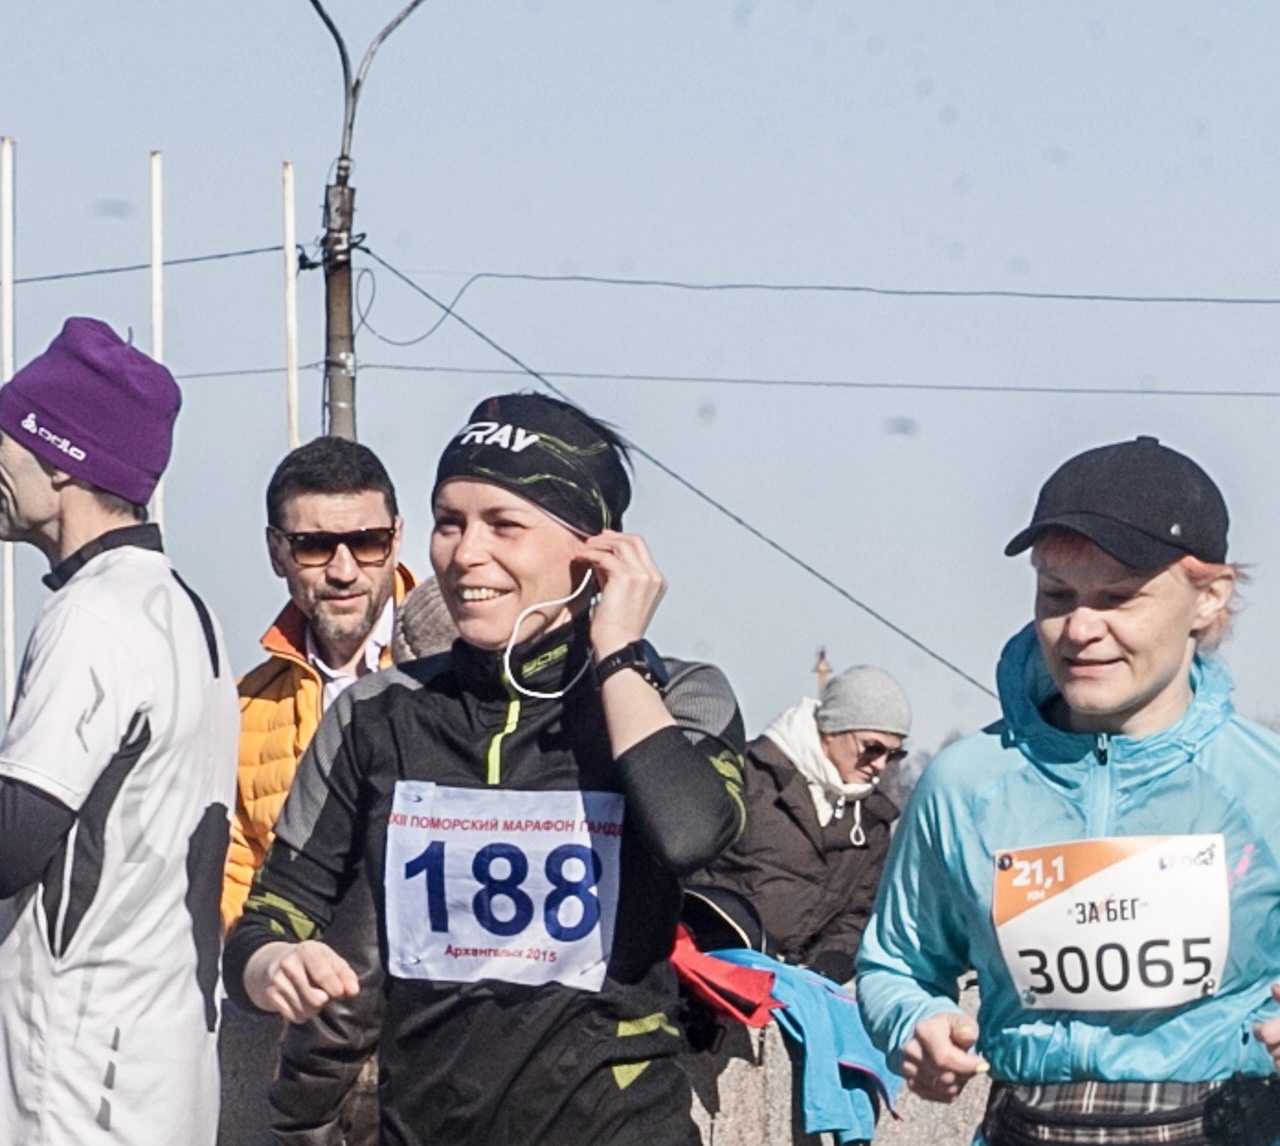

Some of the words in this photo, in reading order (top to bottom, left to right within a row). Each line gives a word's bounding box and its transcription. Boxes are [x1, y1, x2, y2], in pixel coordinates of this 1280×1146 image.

[411, 815, 499, 831] ПОМОРСКИЙ
[502, 820, 575, 832] МАРАФОН
[405, 840, 603, 942] 188
[1012, 856, 1065, 889] 21,1
[1018, 937, 1212, 995] 30065
